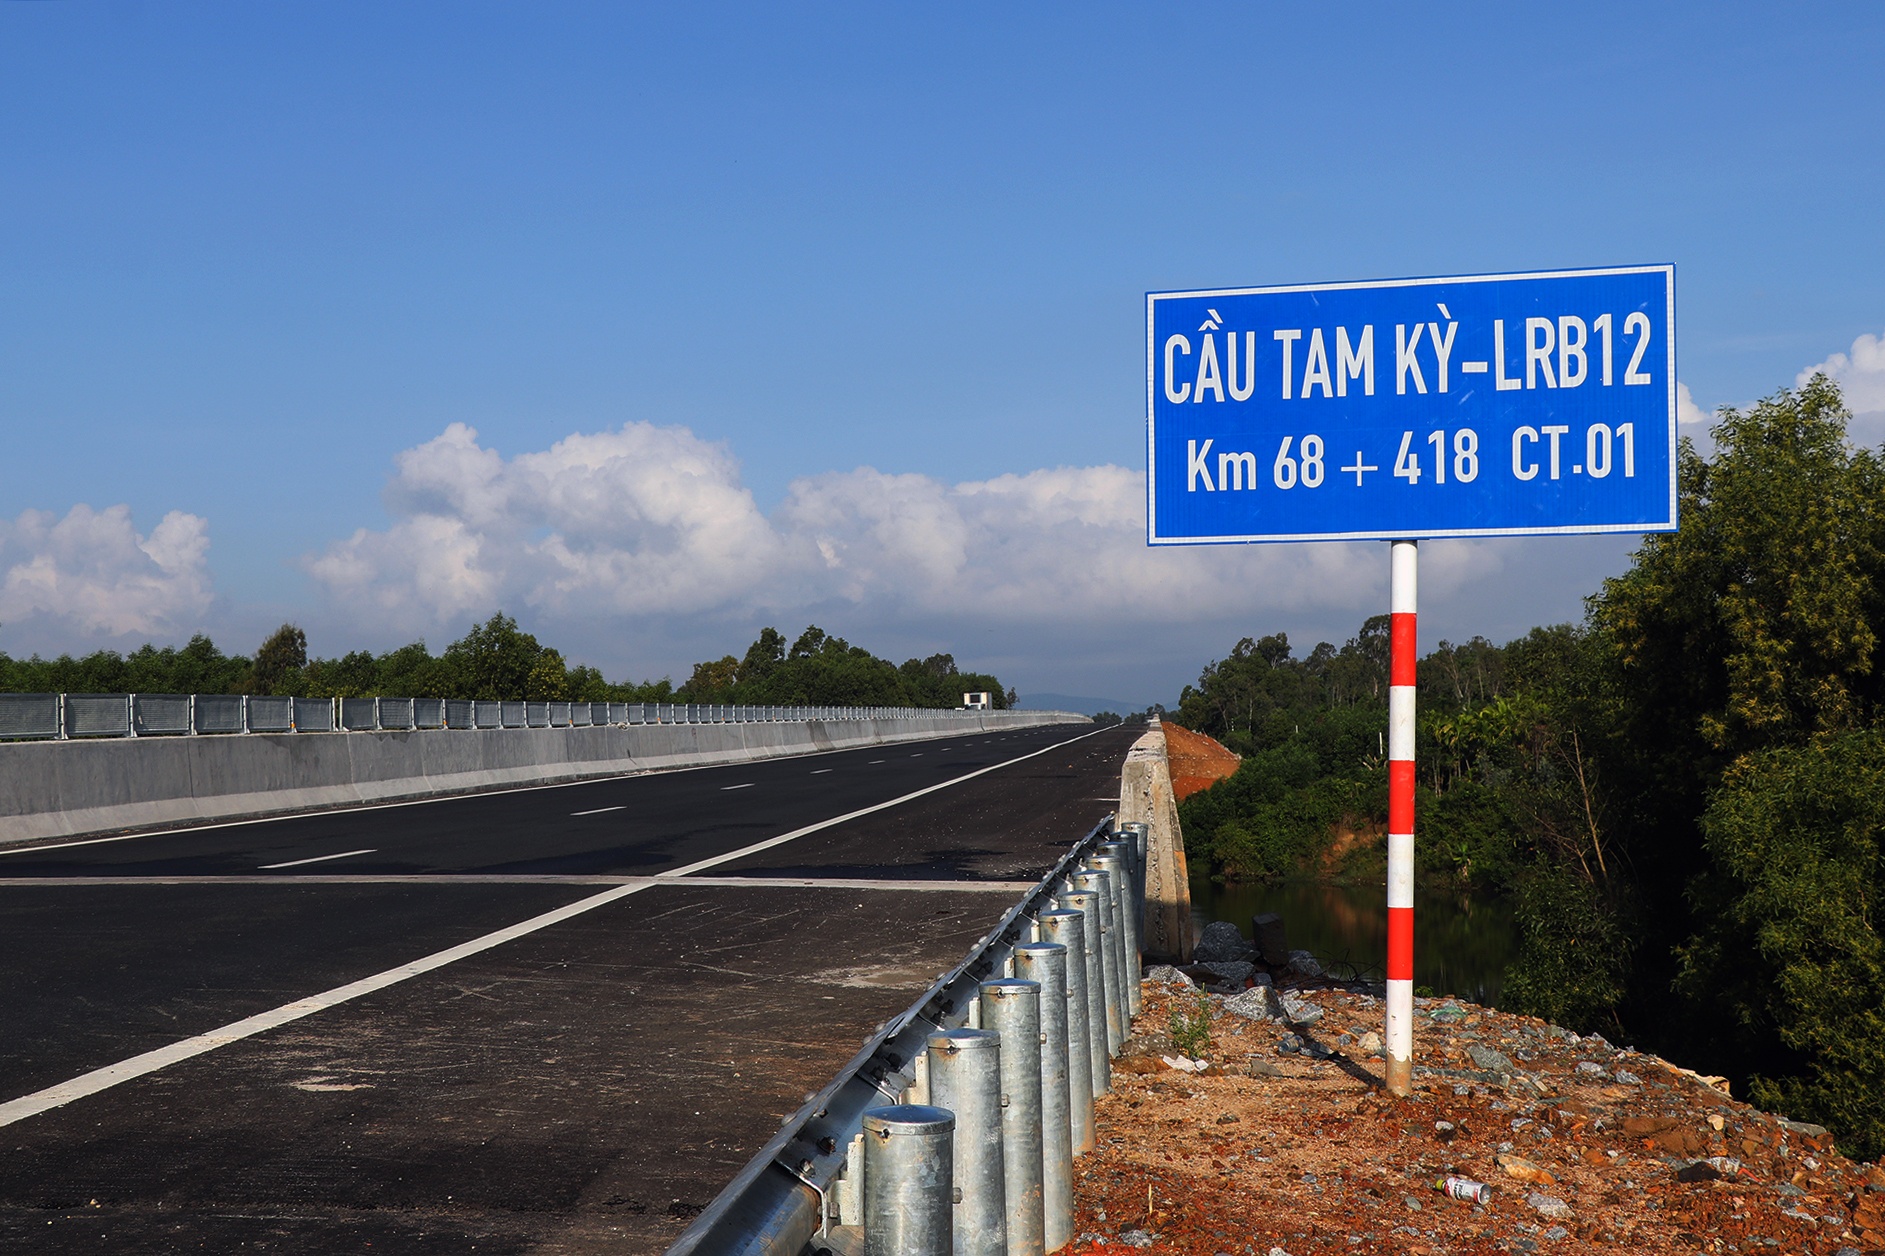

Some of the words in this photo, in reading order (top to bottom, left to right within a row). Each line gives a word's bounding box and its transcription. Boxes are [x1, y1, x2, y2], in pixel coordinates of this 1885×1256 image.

[1164, 308, 1255, 404] CẦU
[1273, 324, 1375, 400] TAM
[1187, 438, 1257, 492] Km
[1273, 434, 1325, 490] 68
[1340, 450, 1379, 487] +
[1393, 428, 1479, 485] 418
[1512, 422, 1635, 481] CT.01
